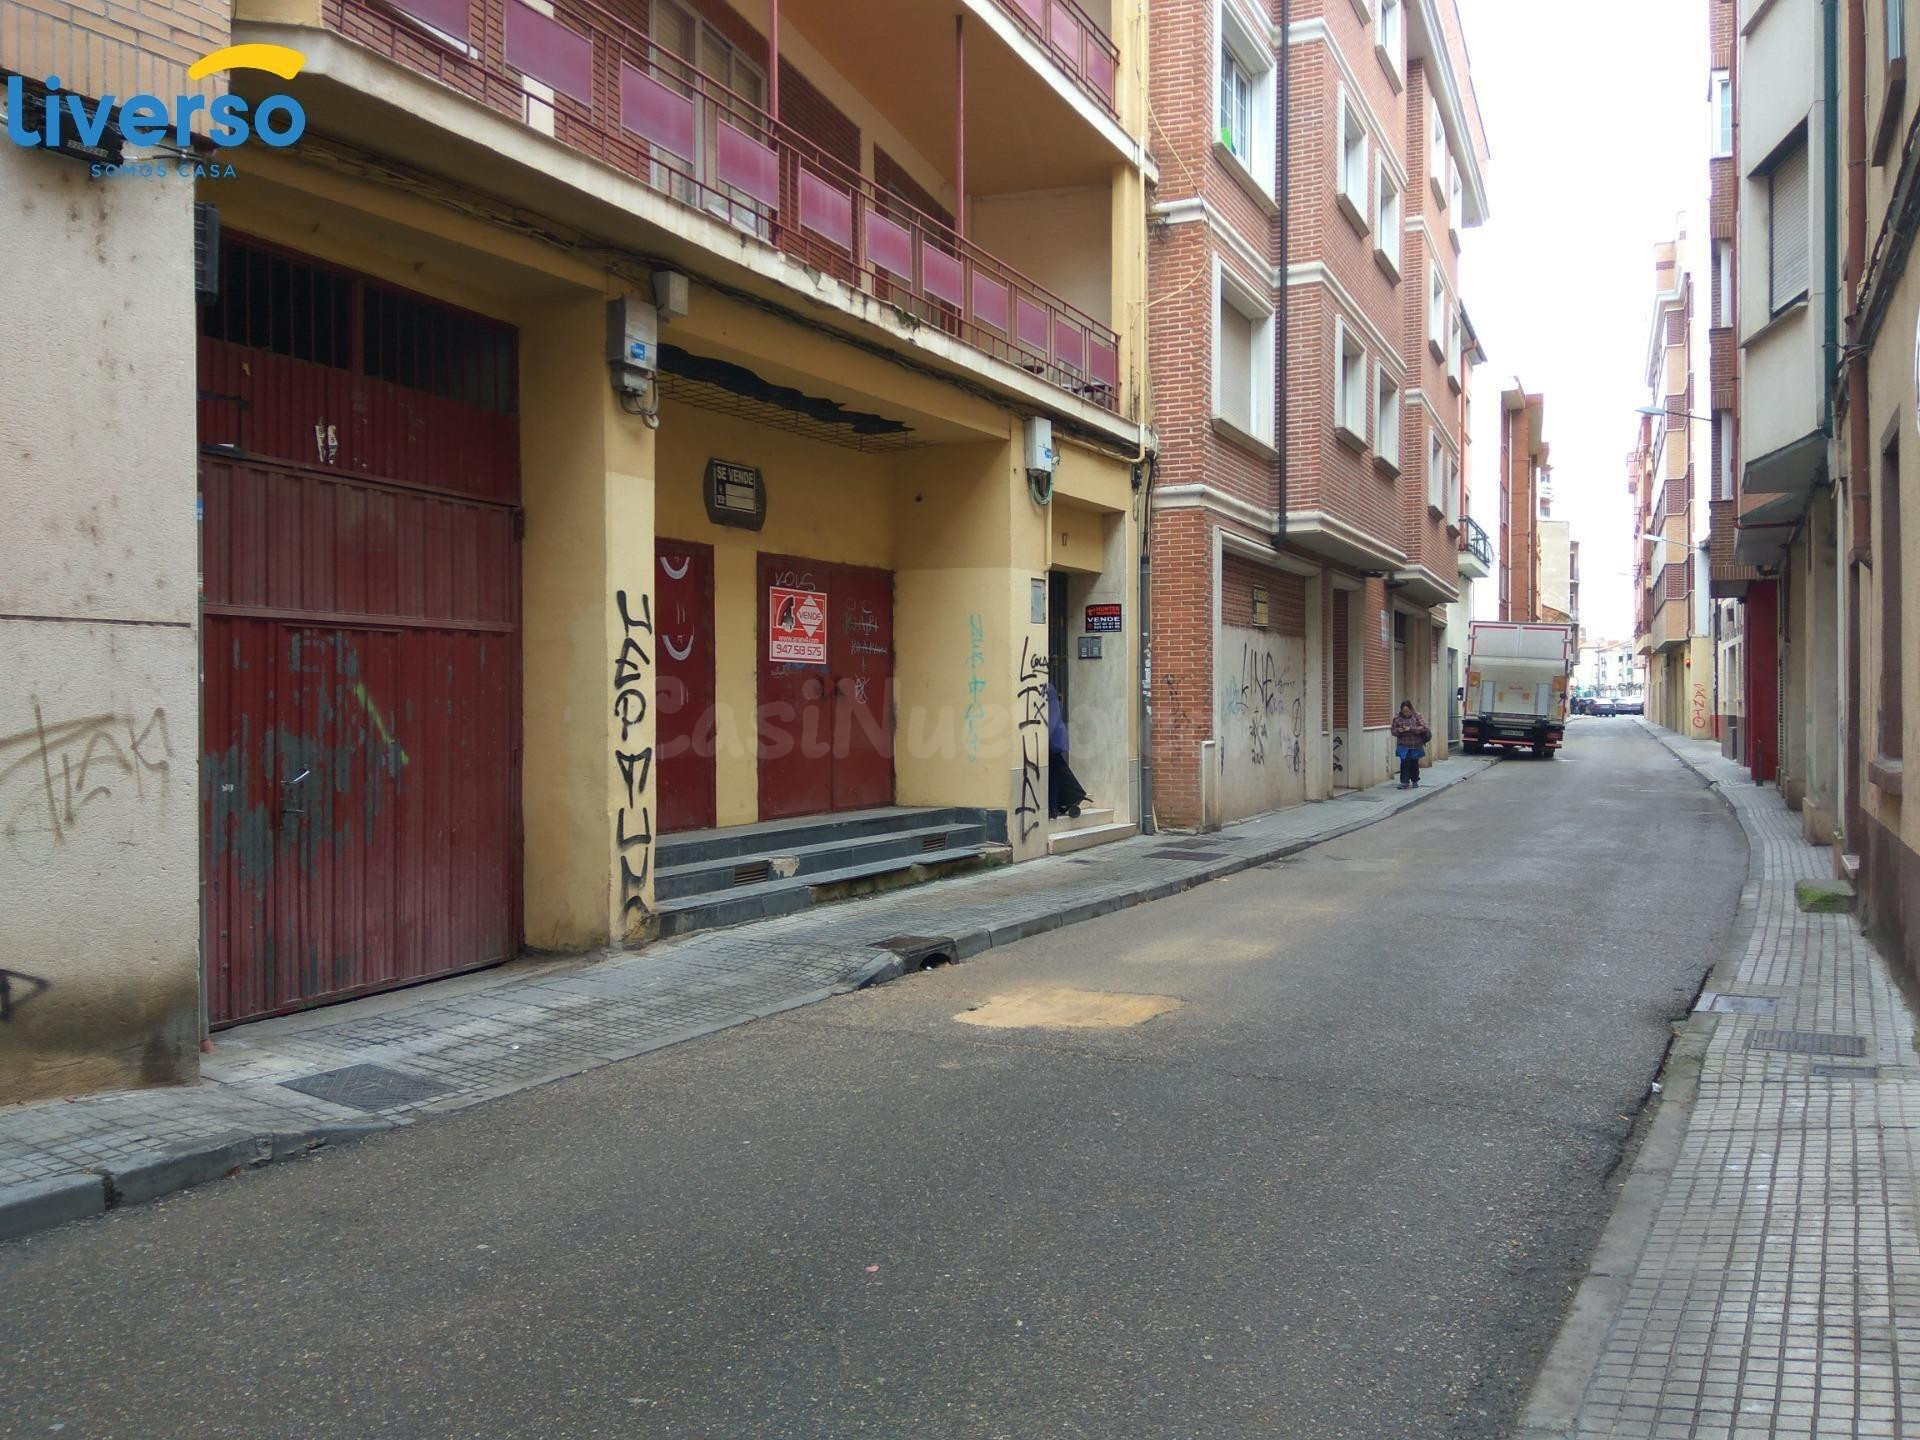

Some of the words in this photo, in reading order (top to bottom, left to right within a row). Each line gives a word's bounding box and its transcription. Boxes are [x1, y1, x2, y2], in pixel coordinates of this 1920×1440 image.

[717, 465, 727, 480] SE
[728, 468, 754, 485] VENDE
[799, 610, 822, 621] VENDE
[776, 644, 792, 654] 947
[807, 646, 822, 656] 575
